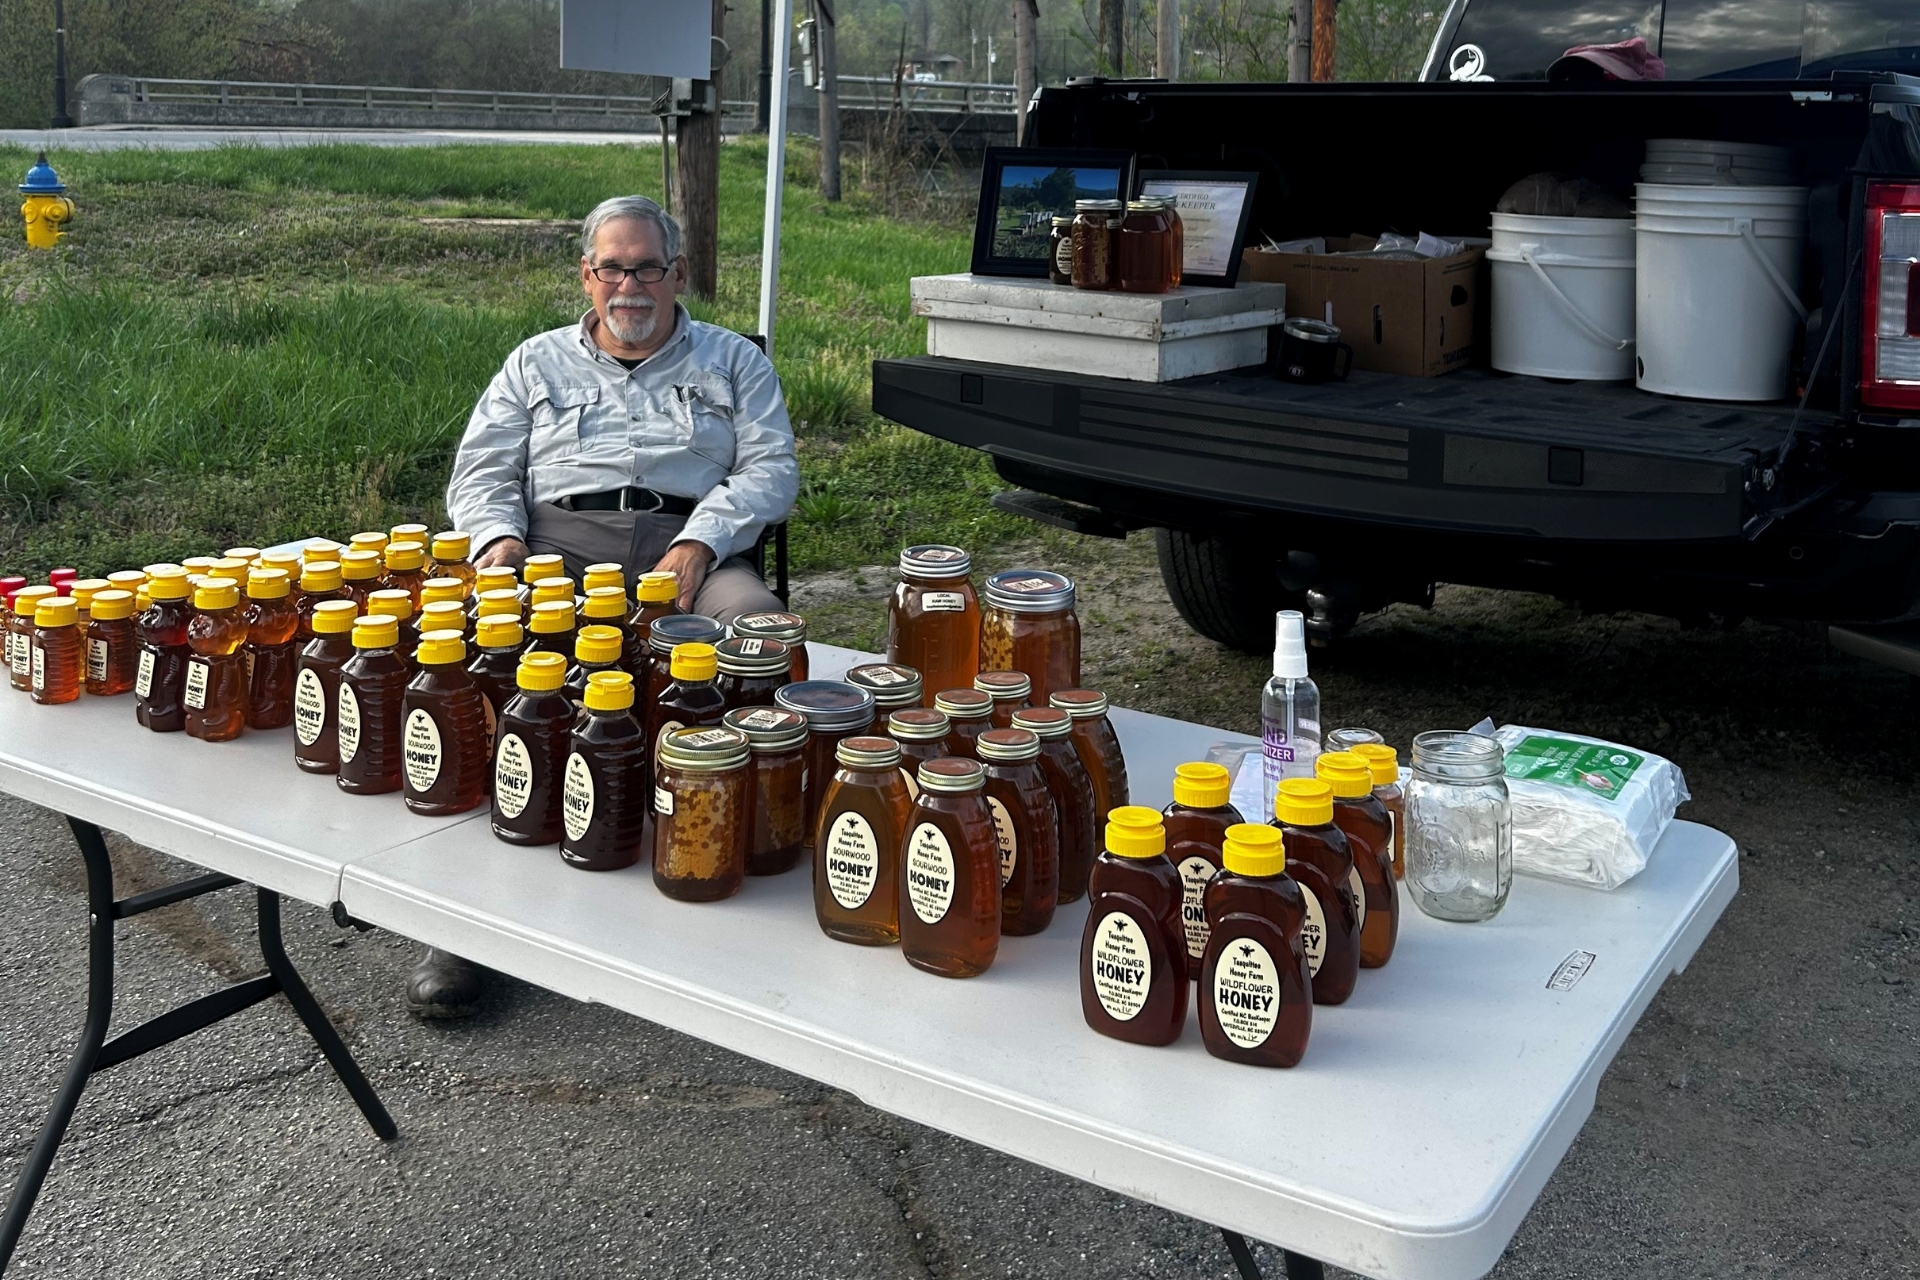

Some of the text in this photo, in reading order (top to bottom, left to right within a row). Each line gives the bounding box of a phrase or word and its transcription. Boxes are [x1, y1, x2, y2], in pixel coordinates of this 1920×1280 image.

[1176, 202, 1216, 210] EKEEPER
[296, 705, 321, 721] HONEY
[1262, 725, 1288, 745] ND
[407, 749, 437, 765] HONEY
[1264, 745, 1291, 761] TIZER
[498, 763, 528, 778] WILDFLOWER
[498, 770, 528, 792] HONEY
[565, 790, 590, 813] HONEY
[833, 847, 871, 861] SOURWOOD
[930, 853, 942, 862] Farm
[829, 858, 873, 878] HONEY
[912, 858, 947, 875] SOURWOOD
[910, 870, 949, 893] HONEY
[1105, 940, 1136, 955] Honey Farm
[1097, 950, 1145, 968] WILDFLOWER
[1097, 960, 1145, 986] HONEY
[1229, 967, 1263, 980] Honey Farm
[1114, 984, 1121, 992] NC
[1220, 977, 1273, 994] WILDFLOWER
[1219, 988, 1273, 1012] HONEY
[1221, 1008, 1238, 1017] Certified
